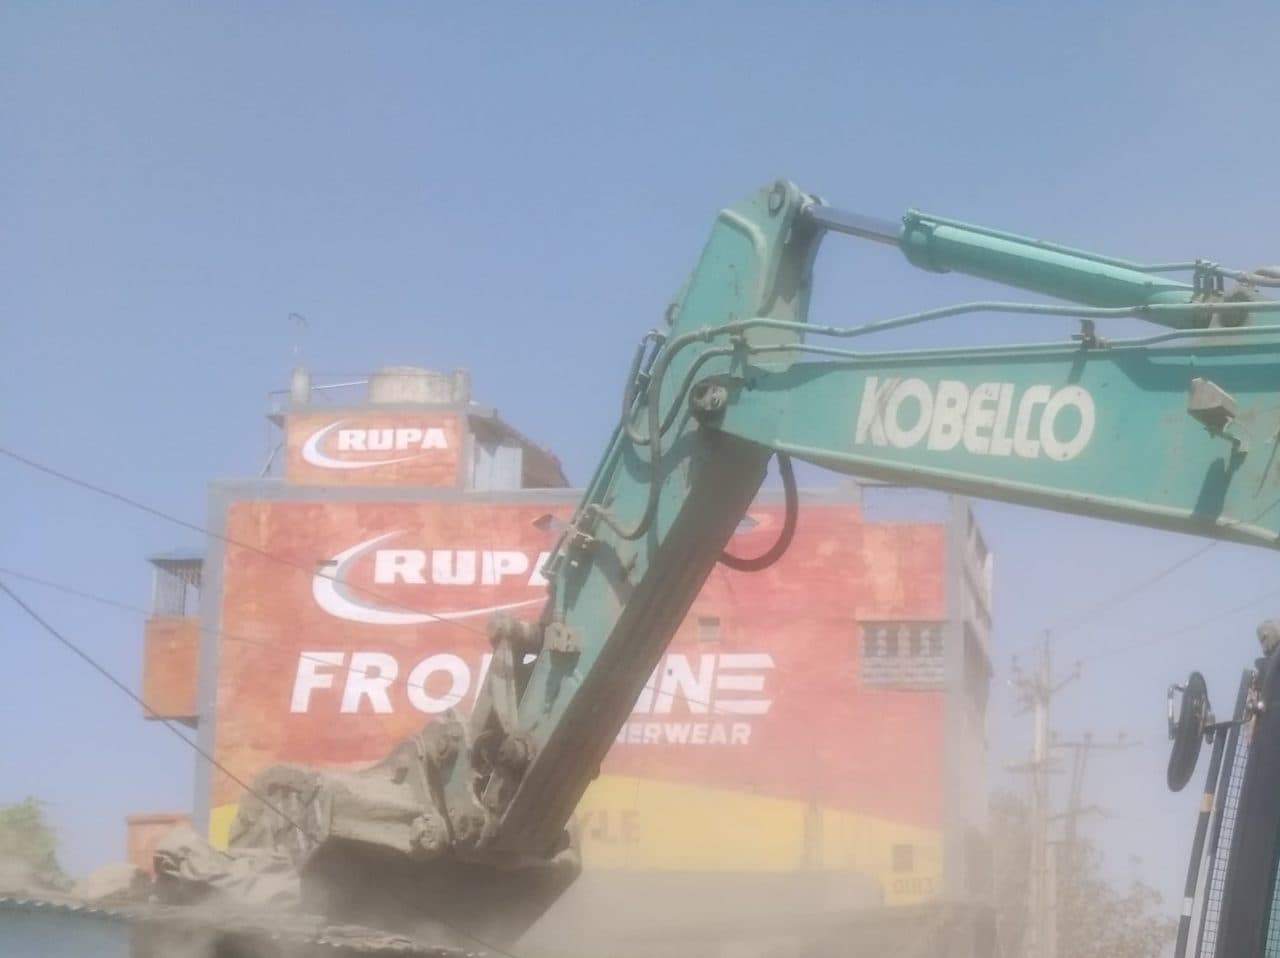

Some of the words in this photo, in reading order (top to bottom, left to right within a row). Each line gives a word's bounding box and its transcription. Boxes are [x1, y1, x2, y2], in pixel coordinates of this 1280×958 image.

[338, 428, 449, 451] RUPA
[855, 376, 1096, 462] KOBELCO
[290, 652, 776, 715] FROINE
[615, 722, 752, 745] ERWEAR
